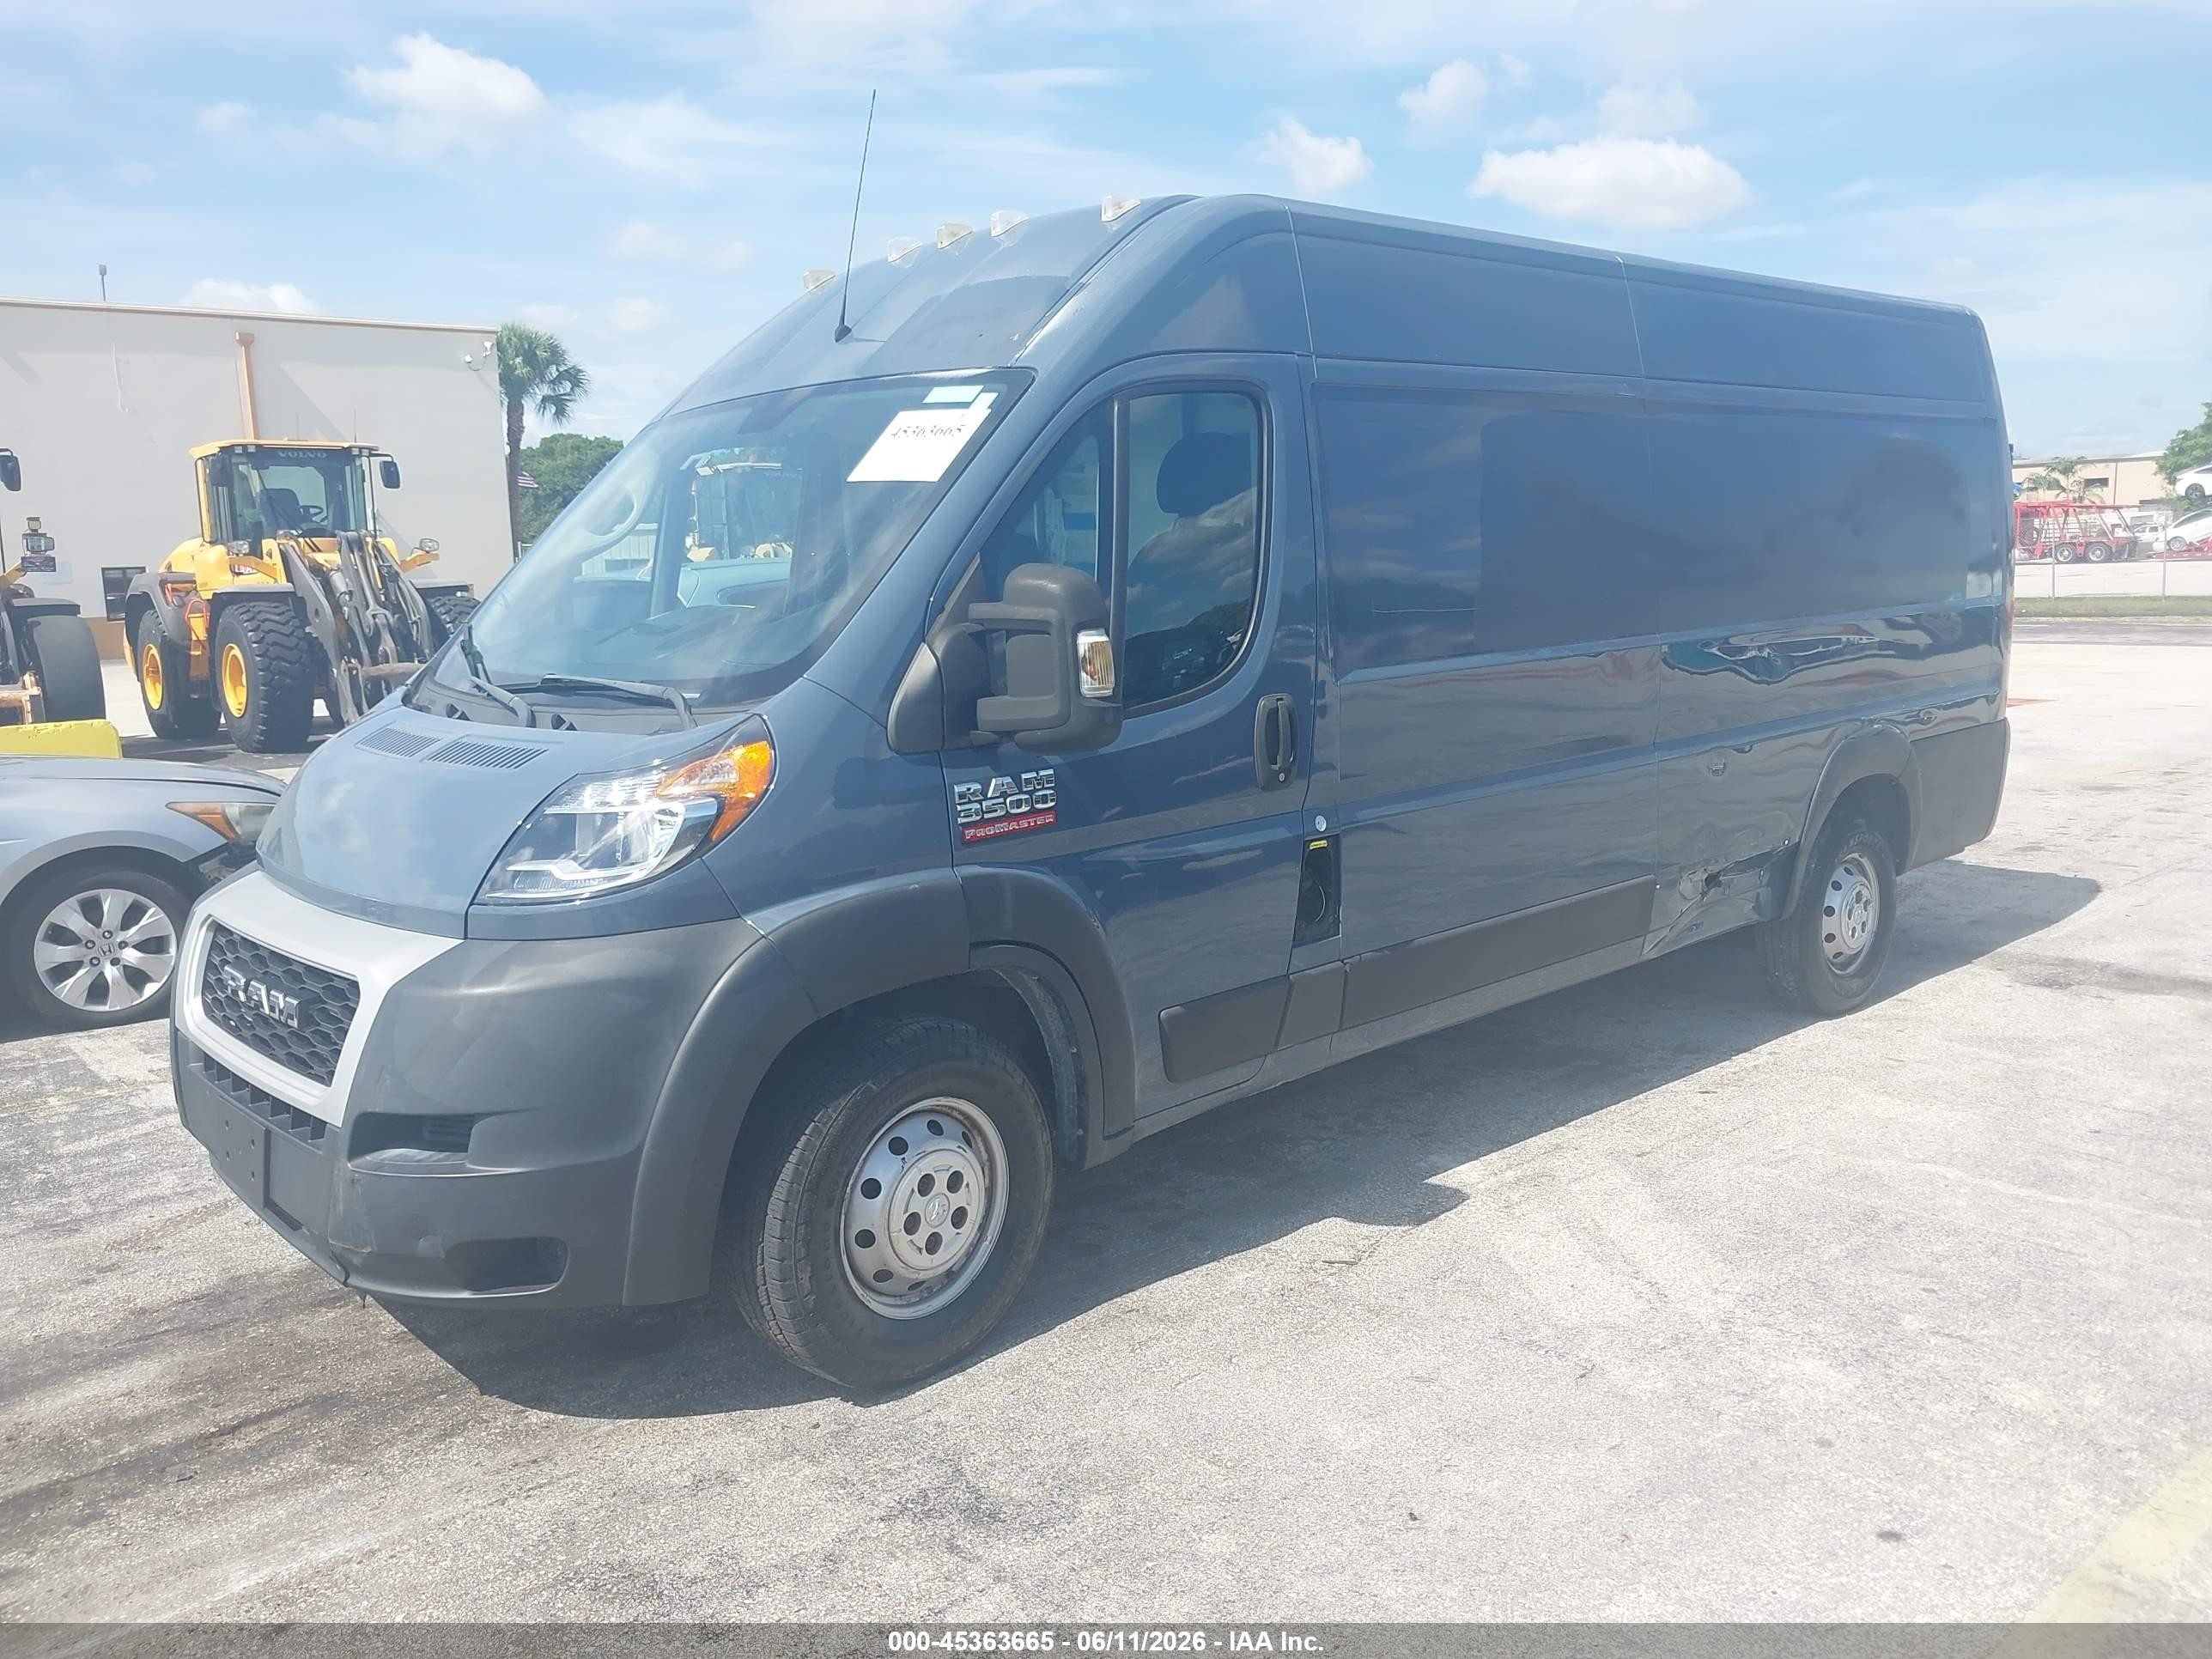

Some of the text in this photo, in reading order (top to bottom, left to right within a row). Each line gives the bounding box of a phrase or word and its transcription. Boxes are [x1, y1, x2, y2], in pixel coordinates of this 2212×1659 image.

[277, 450, 327, 459] VOLVO
[953, 769, 1055, 804] RAM
[956, 789, 1057, 824] 3500
[223, 964, 301, 1029] RAM
